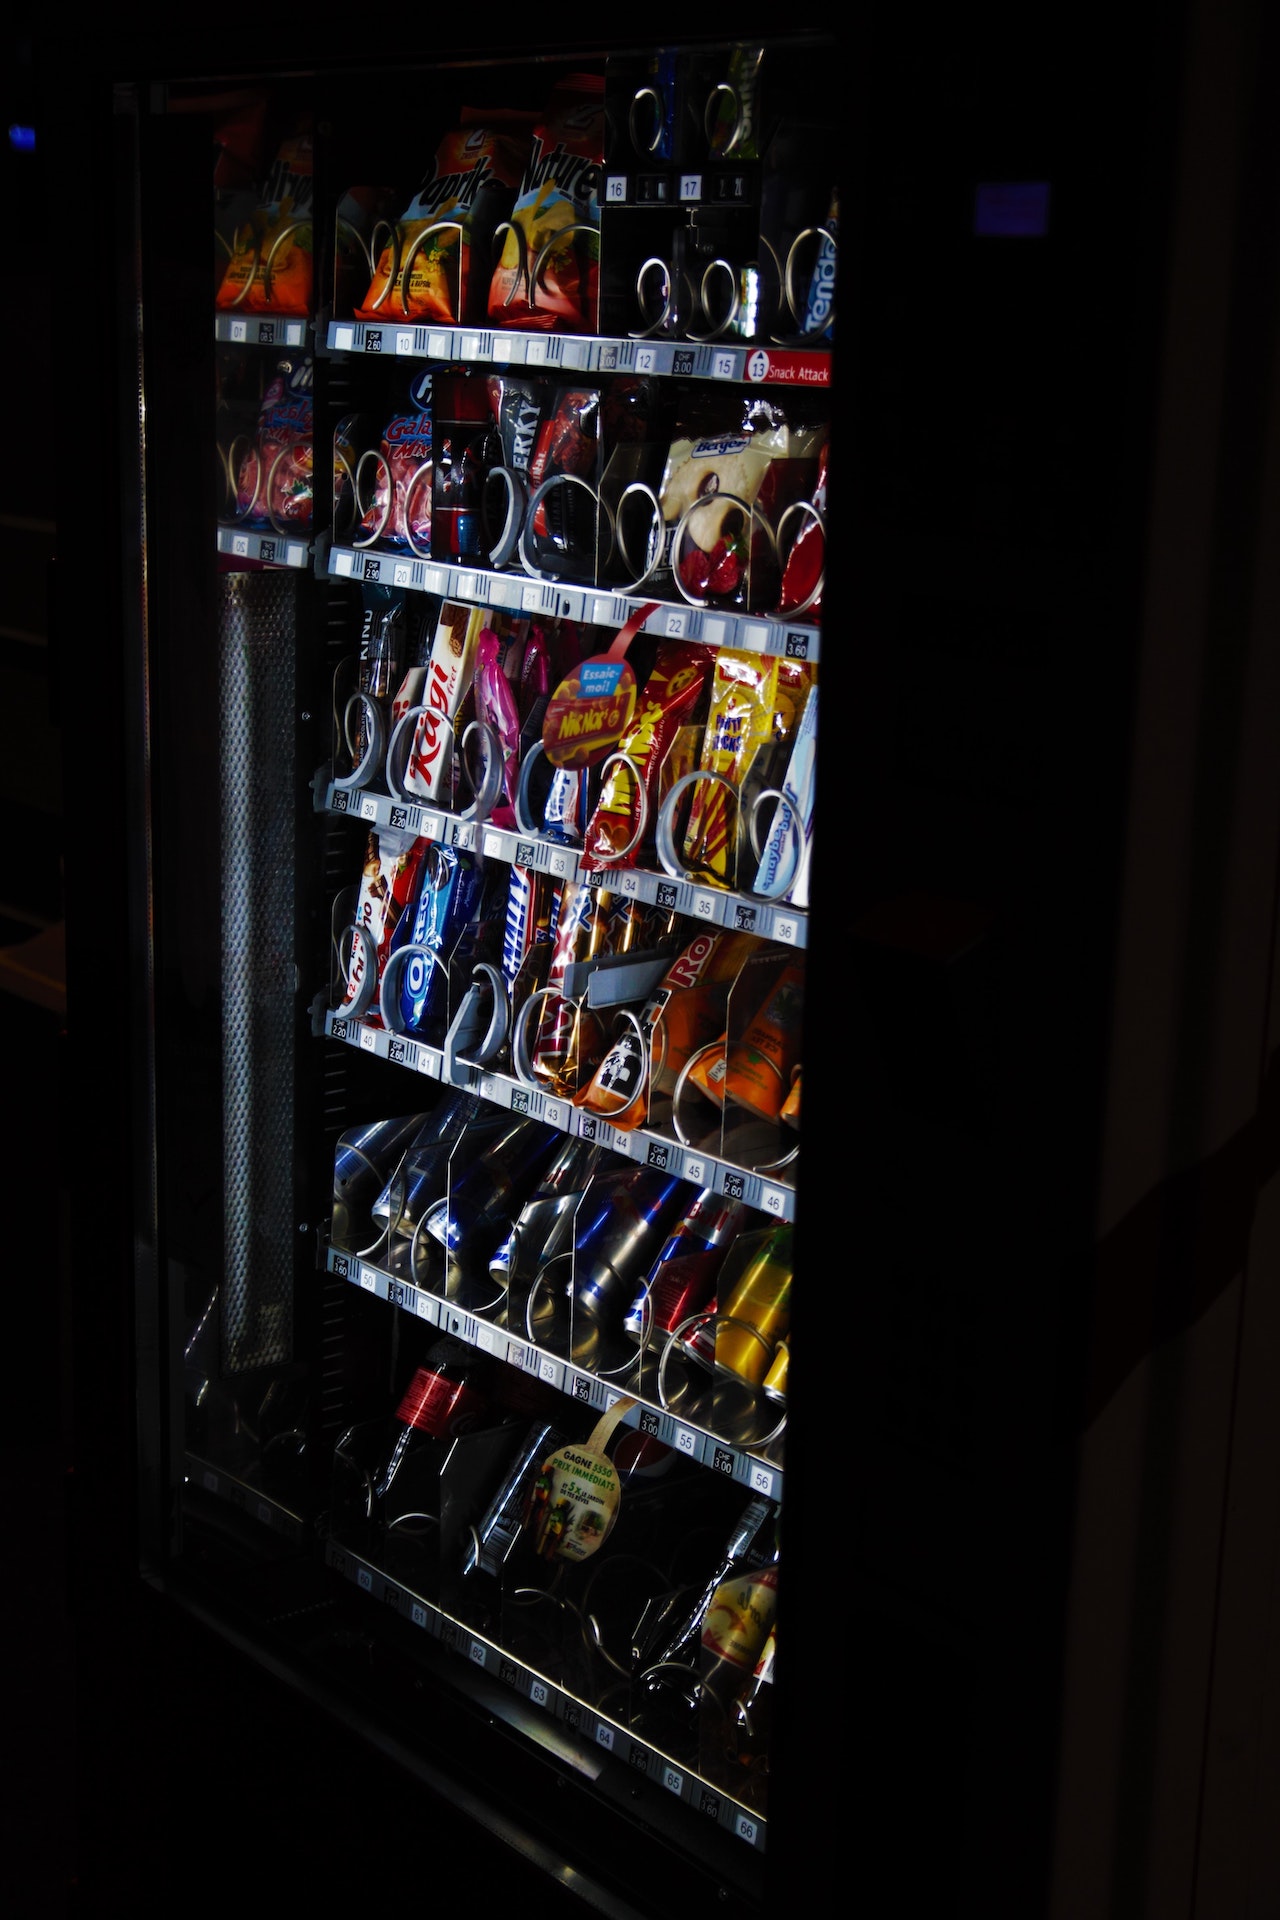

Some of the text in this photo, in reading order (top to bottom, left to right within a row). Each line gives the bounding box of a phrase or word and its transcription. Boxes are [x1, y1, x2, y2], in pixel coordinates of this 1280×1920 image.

[418, 155, 505, 214] aprik
[610, 183, 622, 196] 16
[684, 181, 697, 195] 17
[369, 331, 381, 340] CHF
[366, 339, 381, 350] 2.60
[399, 337, 410, 350] 10
[638, 355, 651, 369] 12
[677, 353, 691, 362] CHF
[674, 361, 692, 374] 3.00
[718, 359, 731, 373] 15
[752, 363, 765, 377] 13
[768, 364, 829, 382] Snack Attack
[393, 438, 432, 459] Mix
[694, 437, 748, 454] Berger
[368, 561, 380, 570] CHF
[365, 569, 380, 581] 2.90
[396, 571, 408, 583] 20
[668, 619, 682, 633] 22
[359, 609, 374, 661] KIND
[791, 634, 806, 643] CHF
[787, 642, 807, 657] 3.60
[582, 666, 619, 682] Essaie-
[584, 680, 611, 694] moi!
[411, 660, 450, 787] Kägi
[333, 798, 347, 811] 3.50
[364, 804, 374, 816] 30
[391, 816, 407, 828] 2.20
[423, 821, 434, 834] 31
[518, 852, 533, 865] 2.20
[553, 859, 565, 872] 33
[624, 878, 636, 891] 34
[661, 884, 675, 895] CHF
[657, 893, 675, 907] 3.90
[698, 901, 711, 914] 35
[778, 924, 792, 938] 36
[335, 1019, 346, 1027] CHF
[332, 1025, 347, 1038] 2.20
[363, 1036, 373, 1047] 40
[389, 1048, 404, 1061] 2.60
[421, 1057, 430, 1068] 41
[515, 1092, 528, 1101] CHF
[513, 1100, 528, 1112] 2.60
[547, 1108, 558, 1121] 43
[616, 1136, 627, 1148] 44
[652, 1145, 666, 1155] CHF
[649, 1153, 667, 1167] 2.60
[688, 1164, 700, 1178] 45
[728, 1175, 743, 1186] CHF
[724, 1183, 743, 1197] 2.60
[767, 1195, 780, 1210] 46
[688, 1201, 730, 1232] Bull
[334, 1262, 348, 1276] 3.60
[363, 1275, 373, 1287] 50
[389, 1290, 403, 1305] 30
[419, 1303, 429, 1314] 51
[543, 1364, 554, 1379] 53
[577, 1386, 589, 1400] .50
[644, 1413, 657, 1424] CHF
[641, 1420, 658, 1436] 3.00
[679, 1434, 692, 1450] 55
[717, 1450, 731, 1461] CHF
[563, 1451, 613, 1478] GAGNE 5550
[714, 1458, 732, 1474] 3.00
[552, 1457, 616, 1492] PRIX IMMÉDIATS
[755, 1473, 769, 1489] 56
[359, 1574, 369, 1587] 60
[414, 1608, 425, 1623] 61
[472, 1647, 483, 1660] 62
[533, 1685, 545, 1701] 63
[599, 1731, 610, 1745] 64
[667, 1773, 680, 1790] 65
[700, 1799, 718, 1818] 3.60
[740, 1821, 753, 1839] 66
